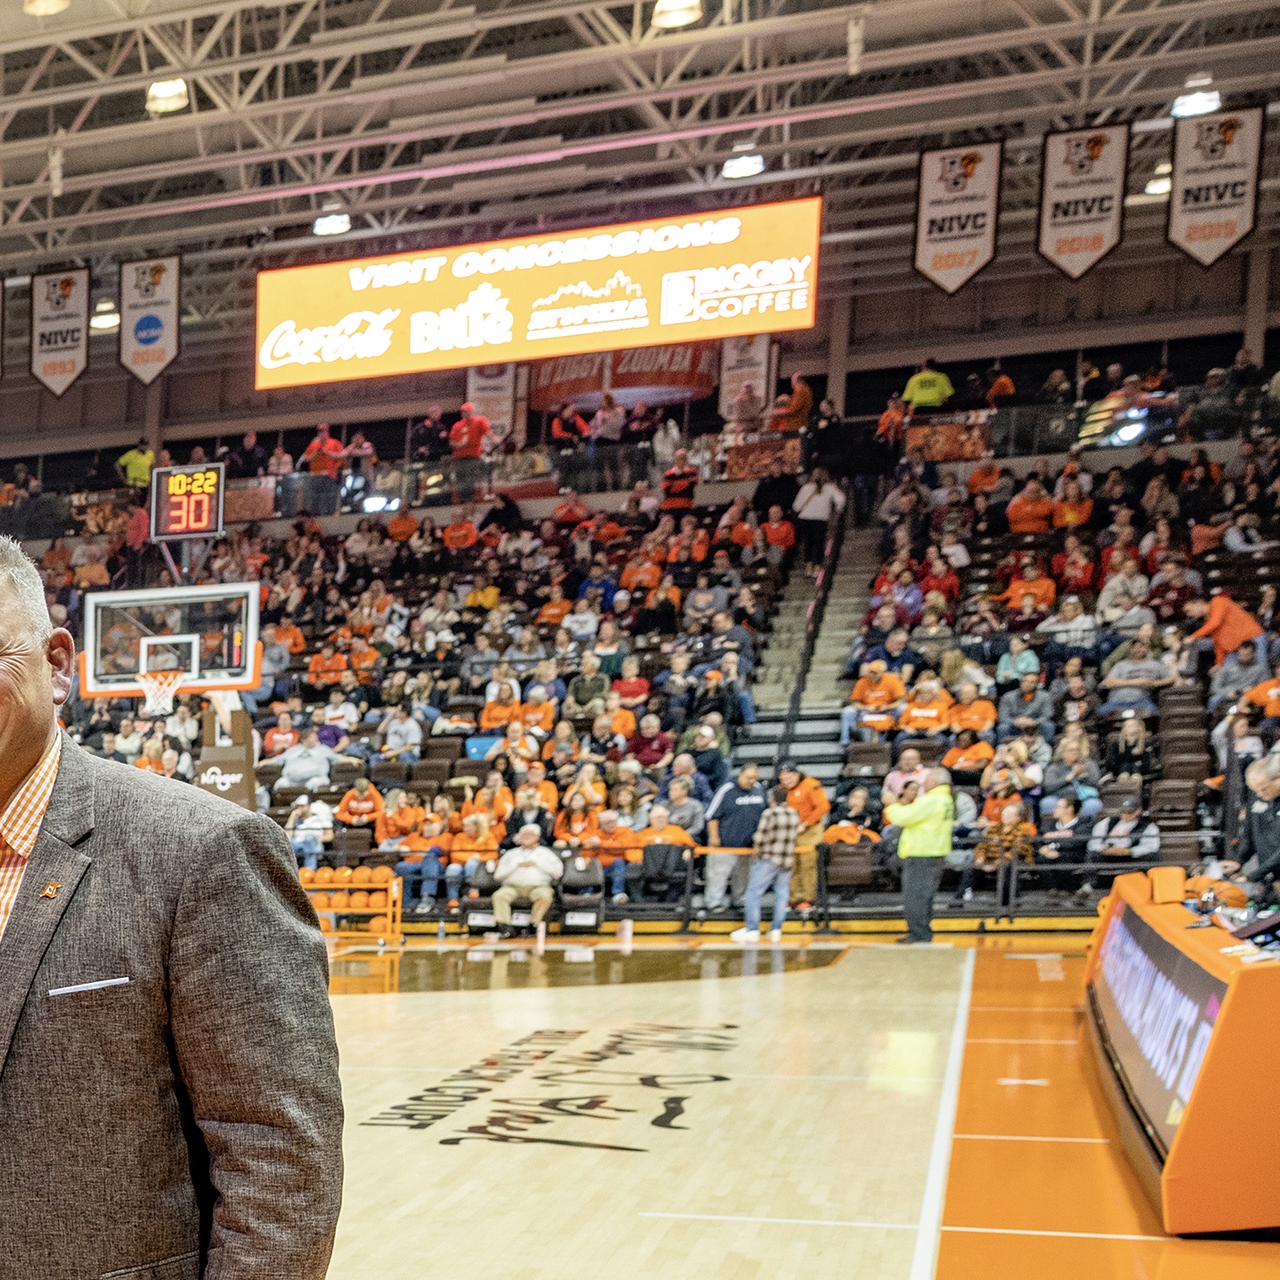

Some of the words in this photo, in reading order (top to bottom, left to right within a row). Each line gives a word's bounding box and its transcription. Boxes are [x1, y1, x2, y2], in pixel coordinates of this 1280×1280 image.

[1051, 195, 1114, 220] NIVC
[1182, 180, 1248, 206] NIVC
[926, 211, 987, 236] NIVC
[348, 256, 448, 291] VISIT
[451, 216, 742, 278] CONCESSIONS
[698, 288, 809, 320] COFFEE
[39, 326, 81, 347] NIVC
[616, 346, 694, 375] ZOOMBA
[167, 471, 218, 495] 10:22
[168, 494, 210, 532] 30
[441, 1048, 557, 1084] FRACK
[357, 1084, 493, 1131] COURT
